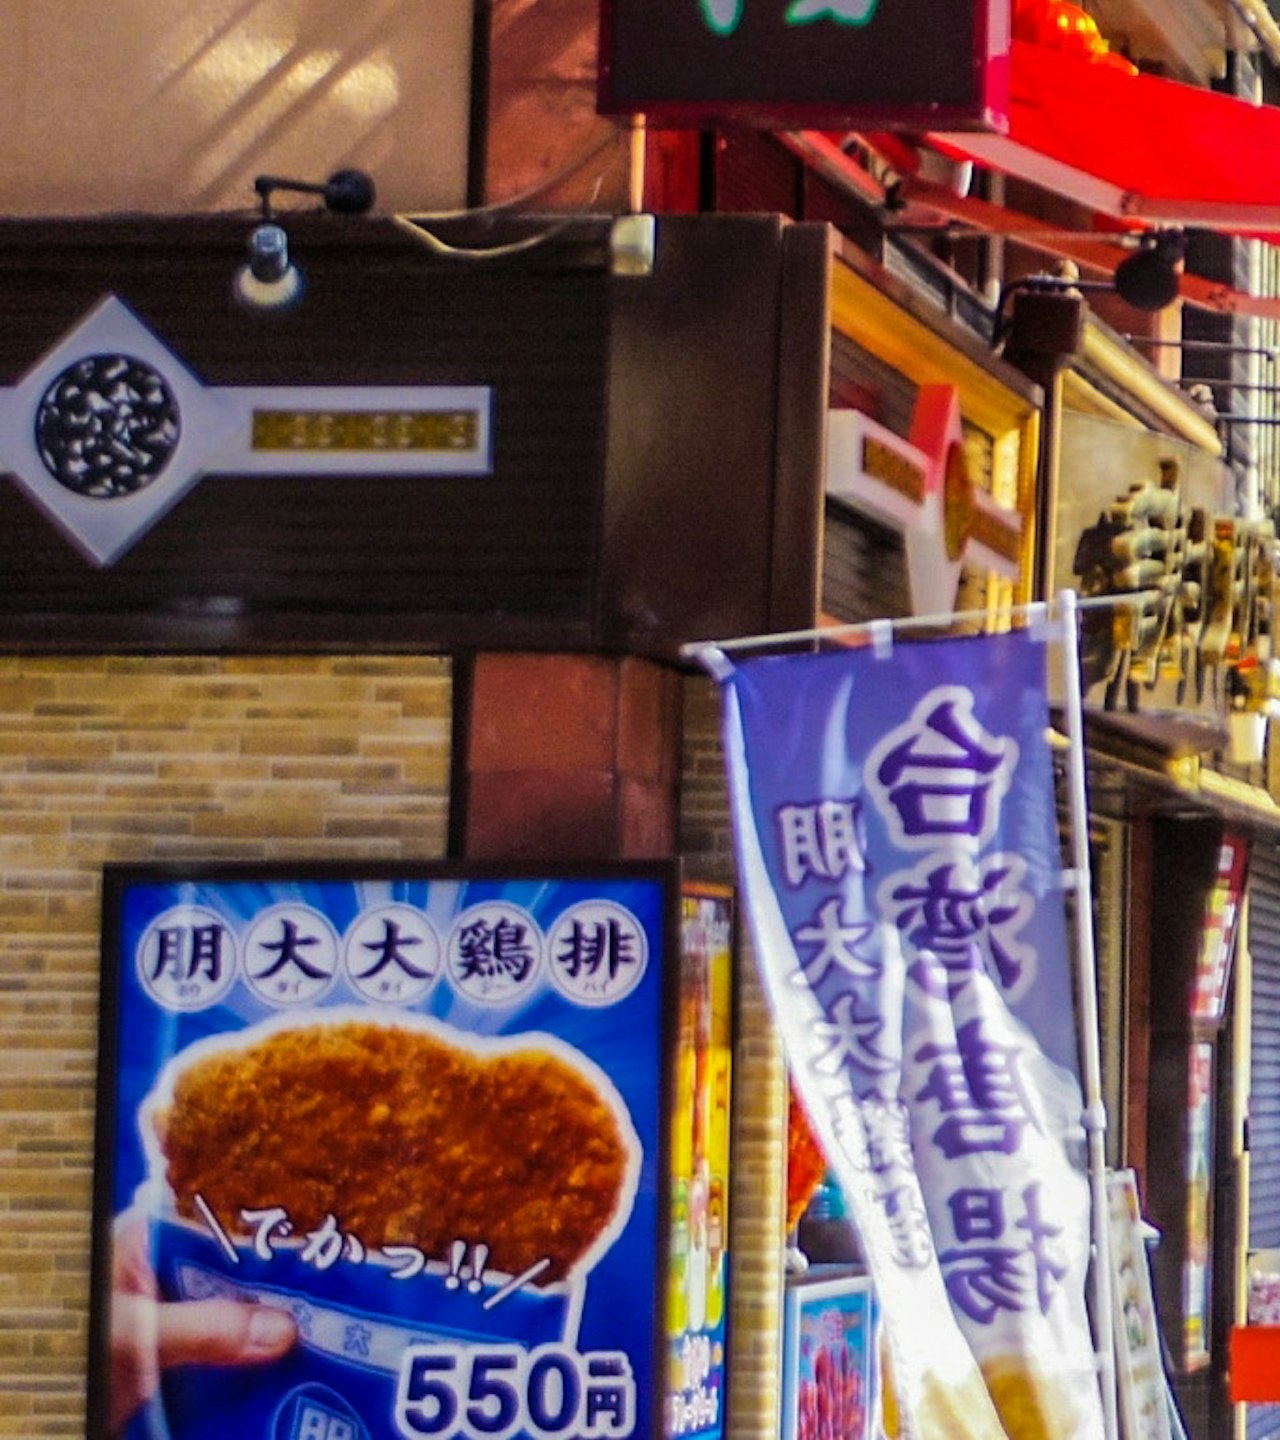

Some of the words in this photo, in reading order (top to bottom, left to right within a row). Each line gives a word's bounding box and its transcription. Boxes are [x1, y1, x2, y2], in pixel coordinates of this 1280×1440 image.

[151, 916, 638, 984] 朋大大鶏排
[400, 1349, 634, 1438] 550円
